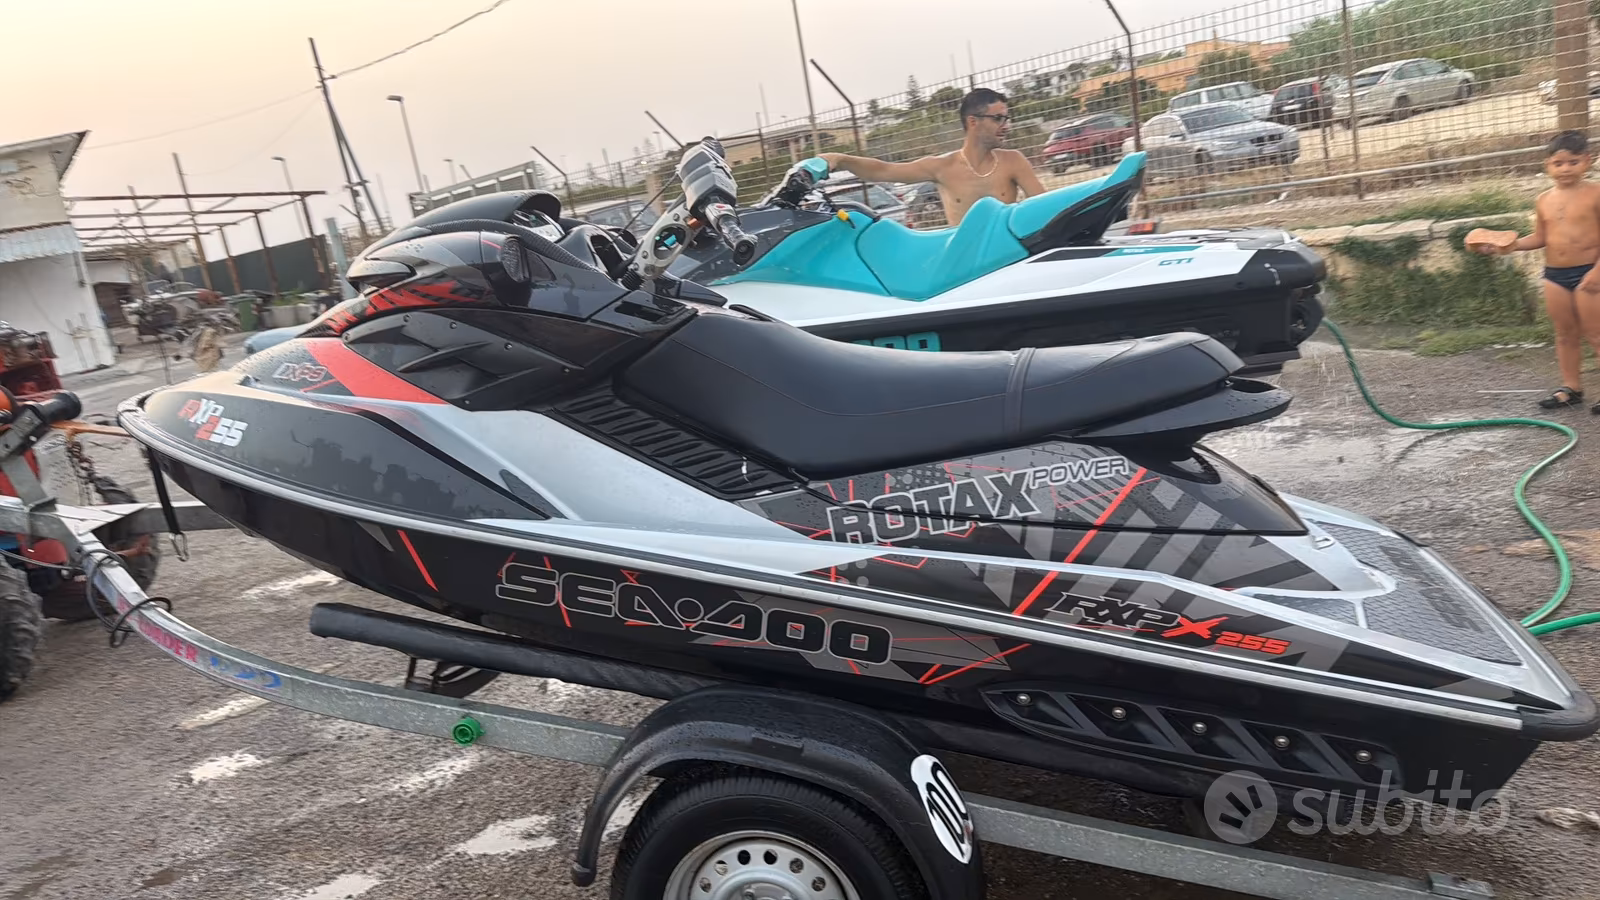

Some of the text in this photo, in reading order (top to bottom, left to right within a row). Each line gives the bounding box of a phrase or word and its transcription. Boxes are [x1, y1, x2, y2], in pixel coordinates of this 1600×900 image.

[1158, 257, 1194, 266] GTI
[177, 398, 225, 424] RXP
[195, 415, 248, 447] 255
[826, 456, 1129, 544] ROTAX POWER
